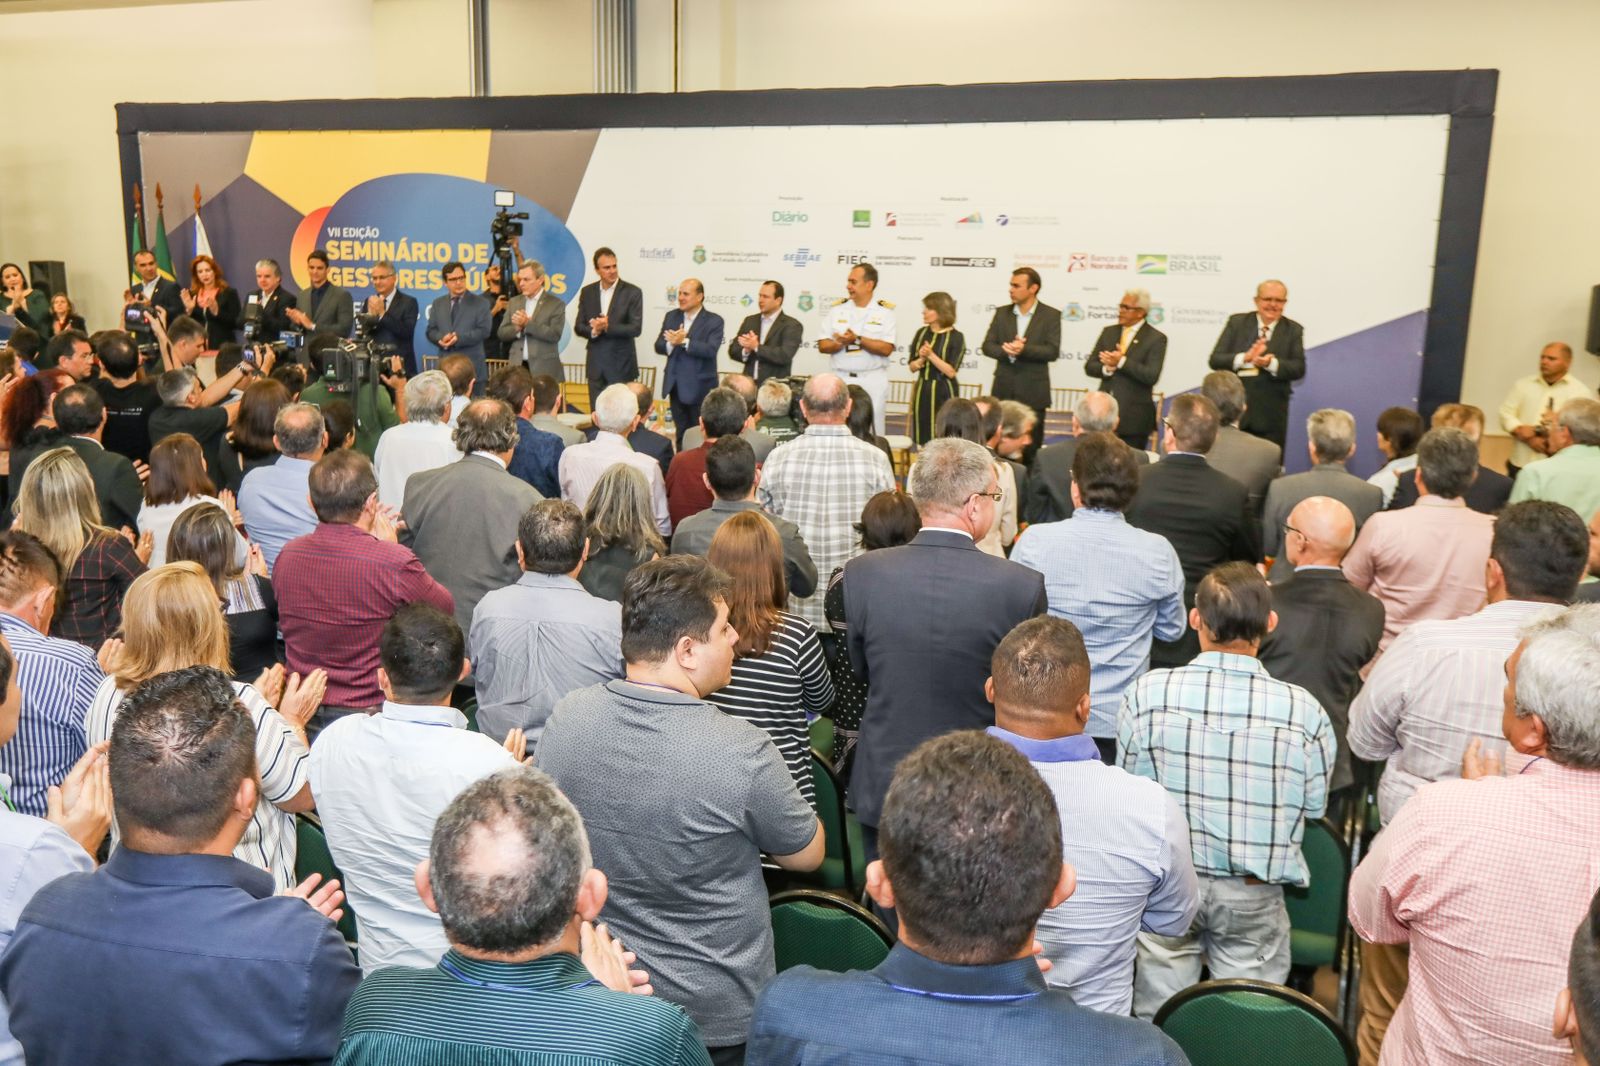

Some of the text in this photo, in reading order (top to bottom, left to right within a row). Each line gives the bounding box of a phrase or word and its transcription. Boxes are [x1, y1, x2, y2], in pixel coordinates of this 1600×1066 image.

[771, 210, 809, 223] Diário
[327, 225, 380, 240] VII EDIÇÃO
[325, 236, 490, 264] SEMINÁRIO DE
[783, 253, 822, 262] SEBRAE
[837, 255, 868, 265] FIEC
[1169, 260, 1222, 272] BRASIL
[326, 266, 443, 290] GESRES
